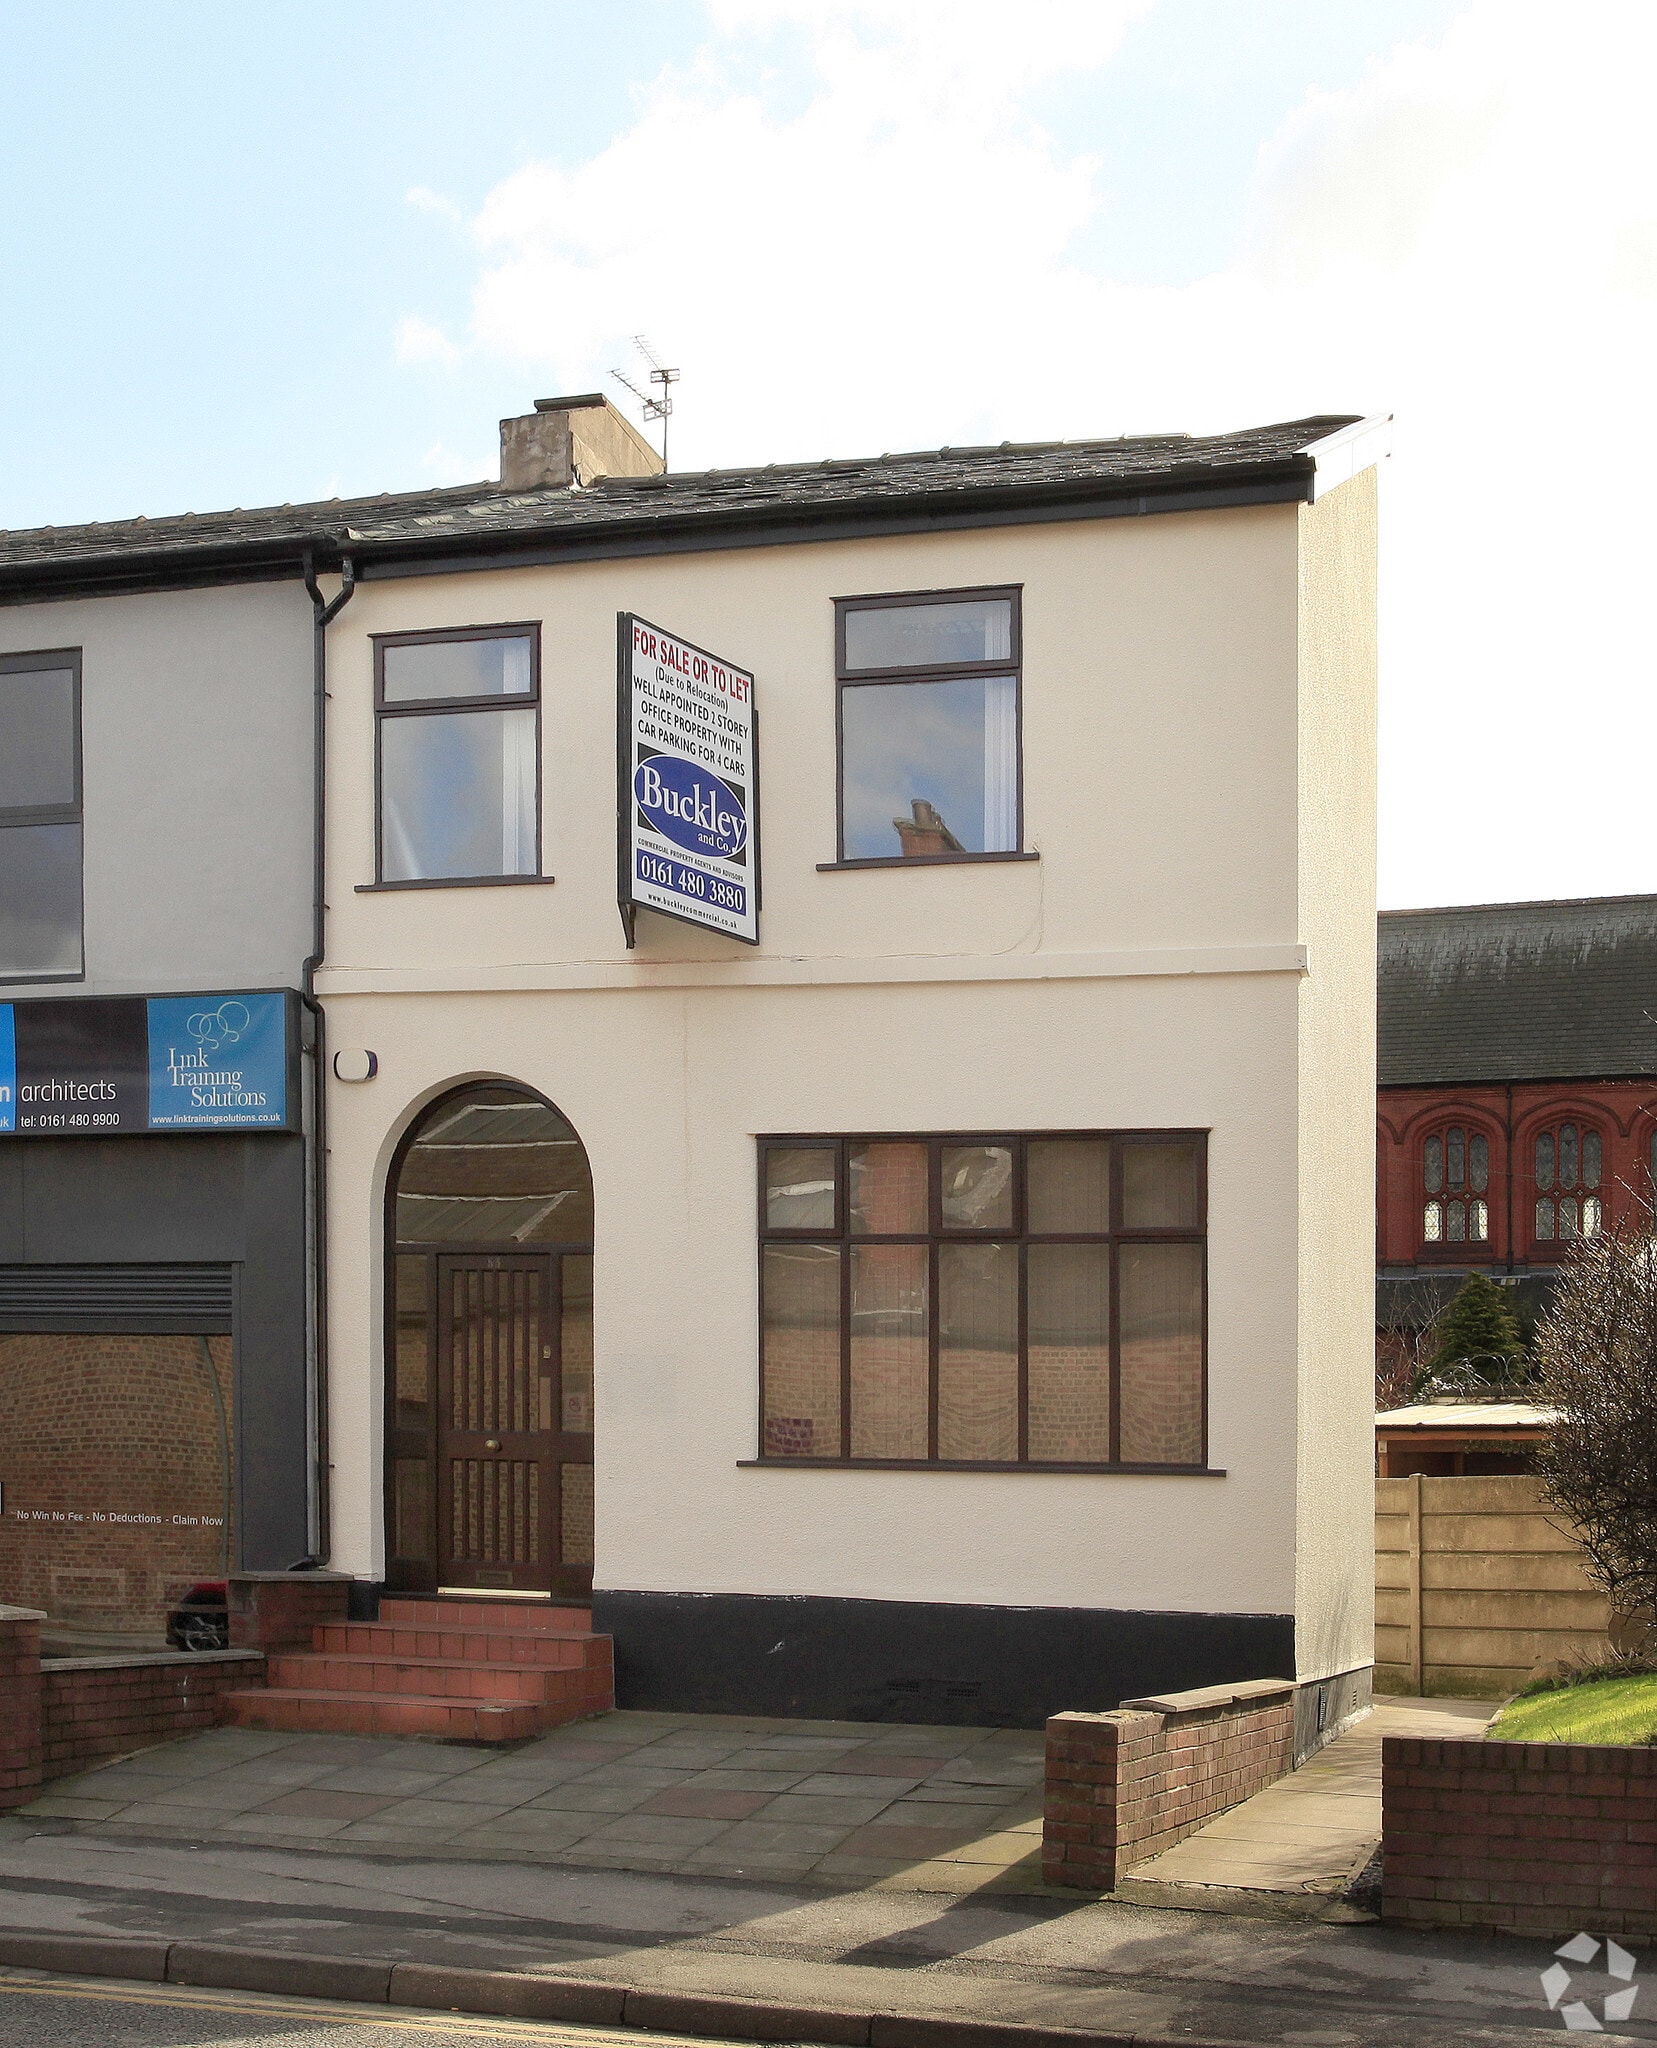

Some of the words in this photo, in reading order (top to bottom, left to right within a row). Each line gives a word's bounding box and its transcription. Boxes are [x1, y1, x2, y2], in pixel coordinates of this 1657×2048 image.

[633, 626, 657, 660] FOR
[660, 640, 689, 676] SALE
[693, 656, 709, 685] OR
[712, 665, 726, 692] TO
[729, 673, 749, 704] LET
[655, 666, 674, 685] (Due
[676, 677, 685, 691] to
[686, 680, 729, 714] Relocation)
[633, 675, 658, 699] WELL
[659, 688, 709, 721] APPOINTED
[711, 711, 716, 725] 2
[717, 714, 749, 739] STOREY
[641, 700, 672, 726] OFFICE
[674, 714, 718, 745] PROPERTY
[718, 733, 742, 756] WITH
[638, 719, 656, 739] CAR
[658, 728, 696, 755] PARKING
[698, 745, 715, 764] FOR
[717, 753, 722, 767] 4
[723, 755, 745, 777] CARS
[640, 764, 746, 852] Buckley
[637, 837, 669, 855] COMMERCIAL
[698, 832, 715, 847] and
[716, 838, 731, 853] Co.
[641, 855, 674, 887] 0161
[678, 869, 705, 897] 480
[709, 880, 743, 911] 3880
[647, 892, 738, 929] www.buckleycommercial.co.uk
[168, 1047, 209, 1068] Link
[21, 1078, 117, 1102] architects
[167, 1065, 243, 1091] Training
[191, 1086, 267, 1107] Solutions
[20, 1115, 36, 1128] tel:
[39, 1114, 65, 1127] 0161
[69, 1113, 90, 1126] 480
[92, 1112, 120, 1126] 9900
[152, 1112, 281, 1124] www.linktrainingsolutions.co.uk
[16, 1510, 29, 1520] No
[32, 1510, 50, 1520] Win
[52, 1511, 65, 1521] No
[92, 1511, 106, 1522] No
[109, 1512, 162, 1524] Deductions
[172, 1514, 198, 1525] Claim
[201, 1515, 224, 1526] Now
